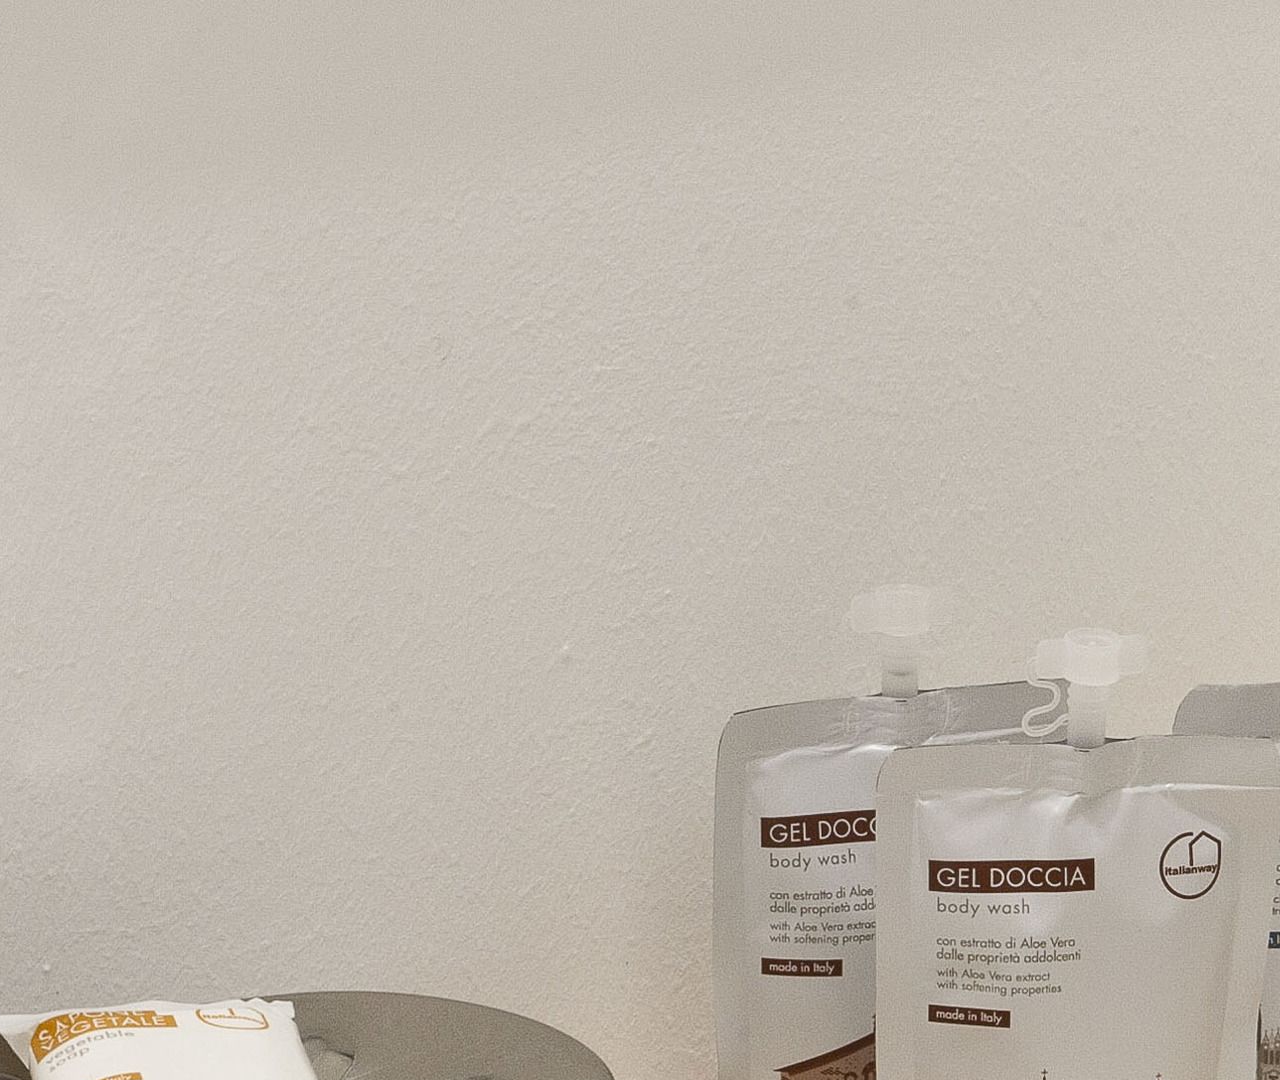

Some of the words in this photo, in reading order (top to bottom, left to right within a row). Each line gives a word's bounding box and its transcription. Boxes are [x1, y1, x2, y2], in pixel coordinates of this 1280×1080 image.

[770, 822, 811, 843] GEL
[770, 853, 811, 872] body
[818, 849, 856, 865] wash
[937, 868, 980, 887] GEL
[990, 866, 1086, 887] DOCCIA
[770, 891, 789, 900] con
[793, 889, 832, 900] estratto
[836, 887, 845, 899] di
[849, 884, 873, 898] Aloe
[770, 901, 796, 913] dalle
[800, 902, 850, 917] proprietà
[854, 898, 876, 912] add
[937, 897, 980, 918] body
[988, 898, 1030, 914] wash
[770, 921, 790, 931] with
[794, 921, 817, 932] Aloe
[821, 922, 843, 932] Vera
[769, 933, 790, 944] with
[794, 933, 839, 946] softening
[936, 937, 956, 946] con
[960, 938, 1001, 948] estratto
[1006, 937, 1016, 949] di
[1020, 937, 1046, 949] Aloe
[1050, 937, 1075, 948] Vera
[936, 948, 963, 960] dalle
[968, 953, 1020, 965] proprietà
[1024, 949, 1081, 963] addolcenti
[770, 961, 797, 972] made
[801, 962, 810, 972] in
[814, 962, 834, 974] Italy
[937, 968, 958, 978] with
[961, 969, 985, 980] Aloe
[989, 972, 1012, 981] Vera
[1016, 972, 1050, 981] extract
[937, 980, 958, 990] with
[962, 981, 1007, 996] softening
[1011, 984, 1062, 997] properties
[936, 1011, 964, 1020] made
[968, 1011, 977, 1021] in
[980, 1012, 1002, 1025] Italy
[41, 1016, 166, 1050] VEGETALE
[46, 1031, 135, 1064] vegetable
[50, 1048, 89, 1072] soap
